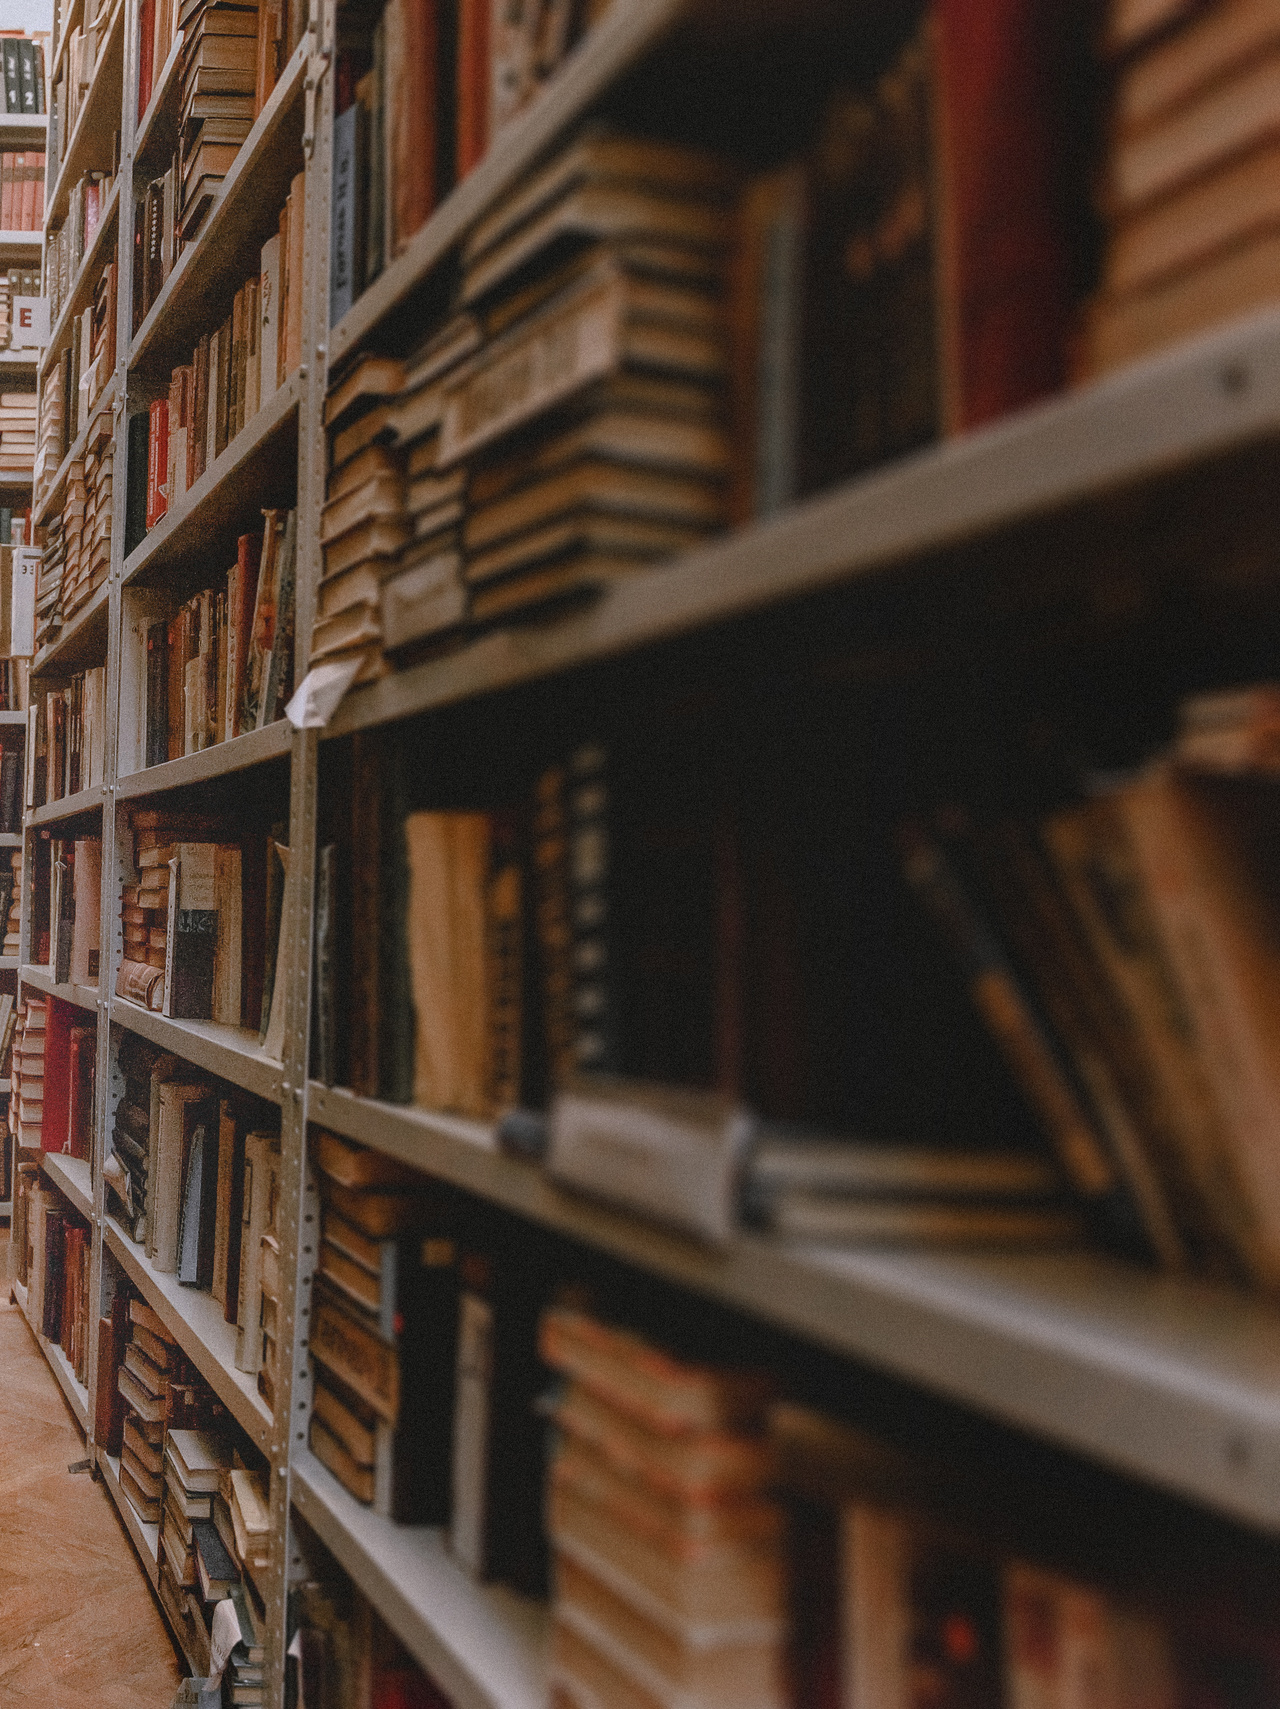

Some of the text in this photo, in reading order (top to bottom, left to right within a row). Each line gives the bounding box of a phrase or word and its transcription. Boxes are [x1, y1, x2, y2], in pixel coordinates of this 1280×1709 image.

[8, 90, 17, 103] 1
[24, 91, 34, 105] 2
[19, 308, 32, 328] Е
